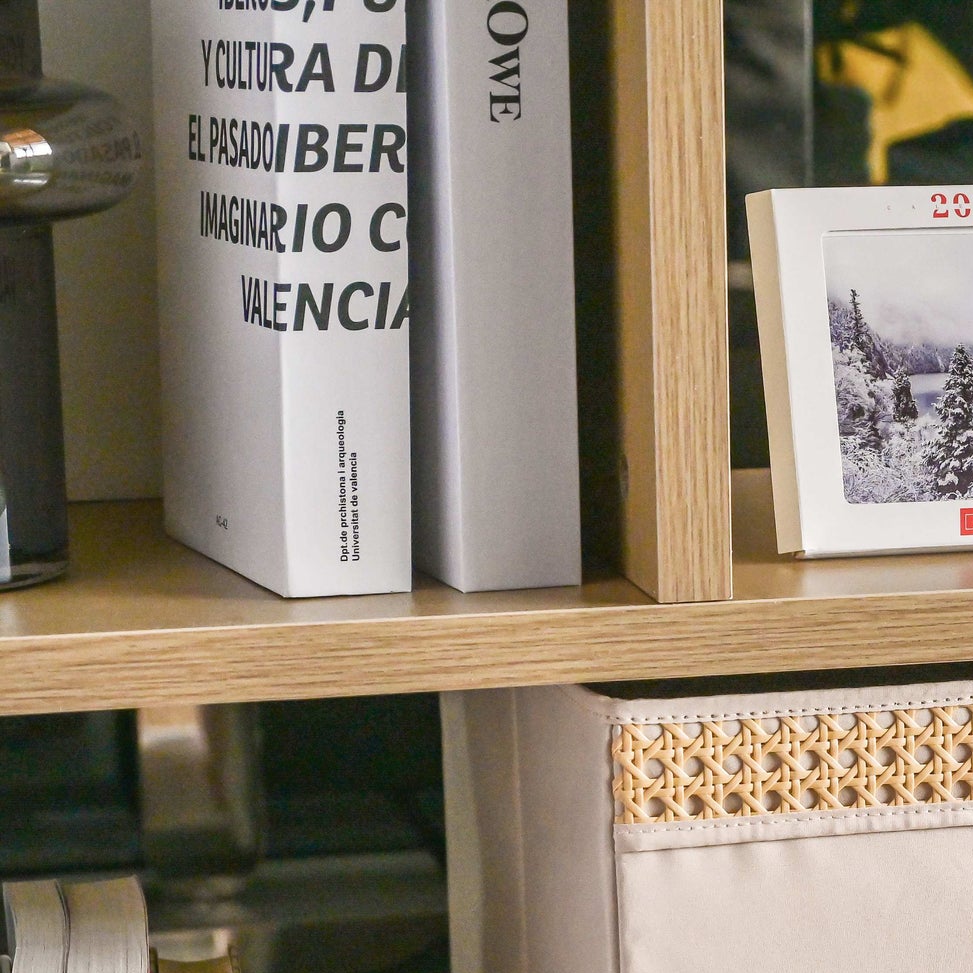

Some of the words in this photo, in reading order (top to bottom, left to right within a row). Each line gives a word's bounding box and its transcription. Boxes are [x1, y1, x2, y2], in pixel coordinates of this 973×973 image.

[201, 39, 213, 87] Y
[215, 40, 336, 93] CULTURA
[188, 113, 206, 163] EL
[209, 116, 275, 171] PASADO
[200, 190, 352, 254] IMAGINARIO
[348, 451, 358, 493] valencia
[349, 494, 359, 507] de
[351, 509, 360, 562] Universitat
